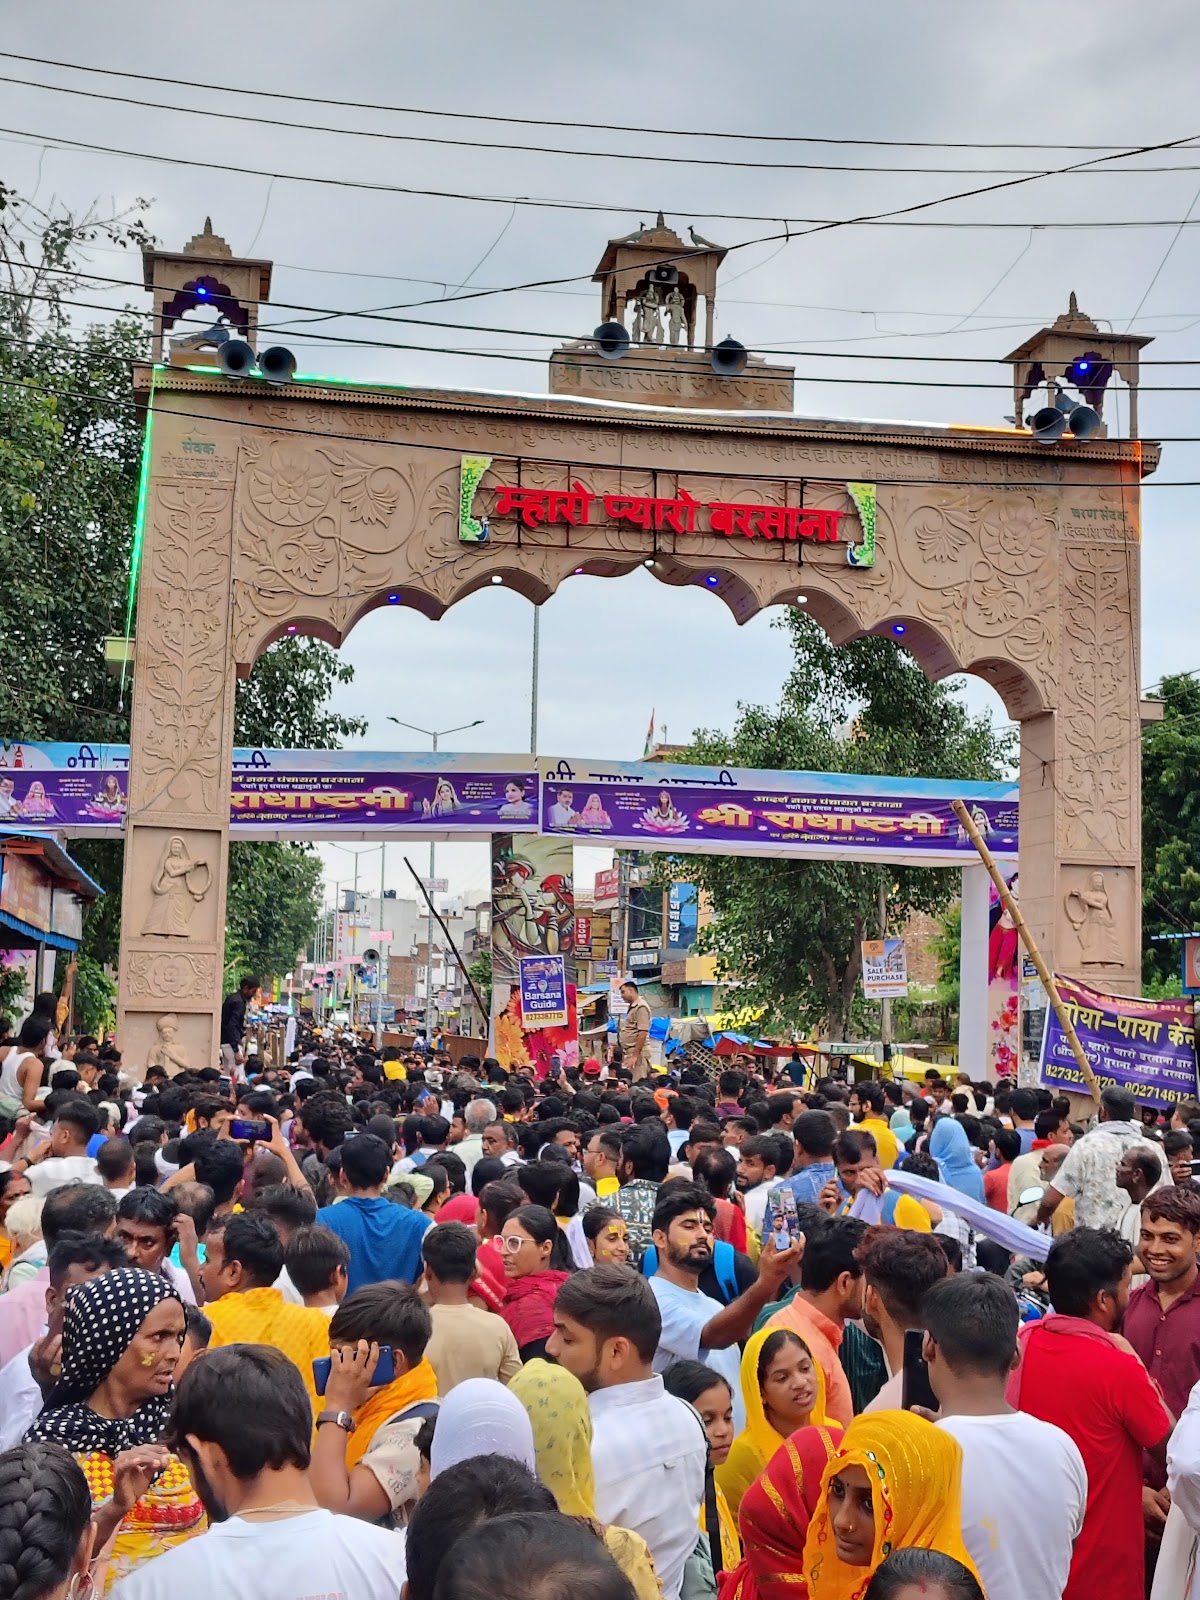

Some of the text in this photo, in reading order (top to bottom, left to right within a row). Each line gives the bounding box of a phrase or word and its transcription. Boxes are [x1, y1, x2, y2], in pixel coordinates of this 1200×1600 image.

[182, 437, 216, 455] सेवक
[495, 480, 844, 542] म्हारो प्यारो बरसाना
[698, 803, 944, 834] श्री राधाष्टमी
[524, 992, 562, 1000] Barsana
[530, 1000, 557, 1009] Guide
[1139, 1052, 1174, 1066] बरसाना
[1104, 1056, 1131, 1070] पुराना
[1162, 1067, 1195, 1082] बरसाना
